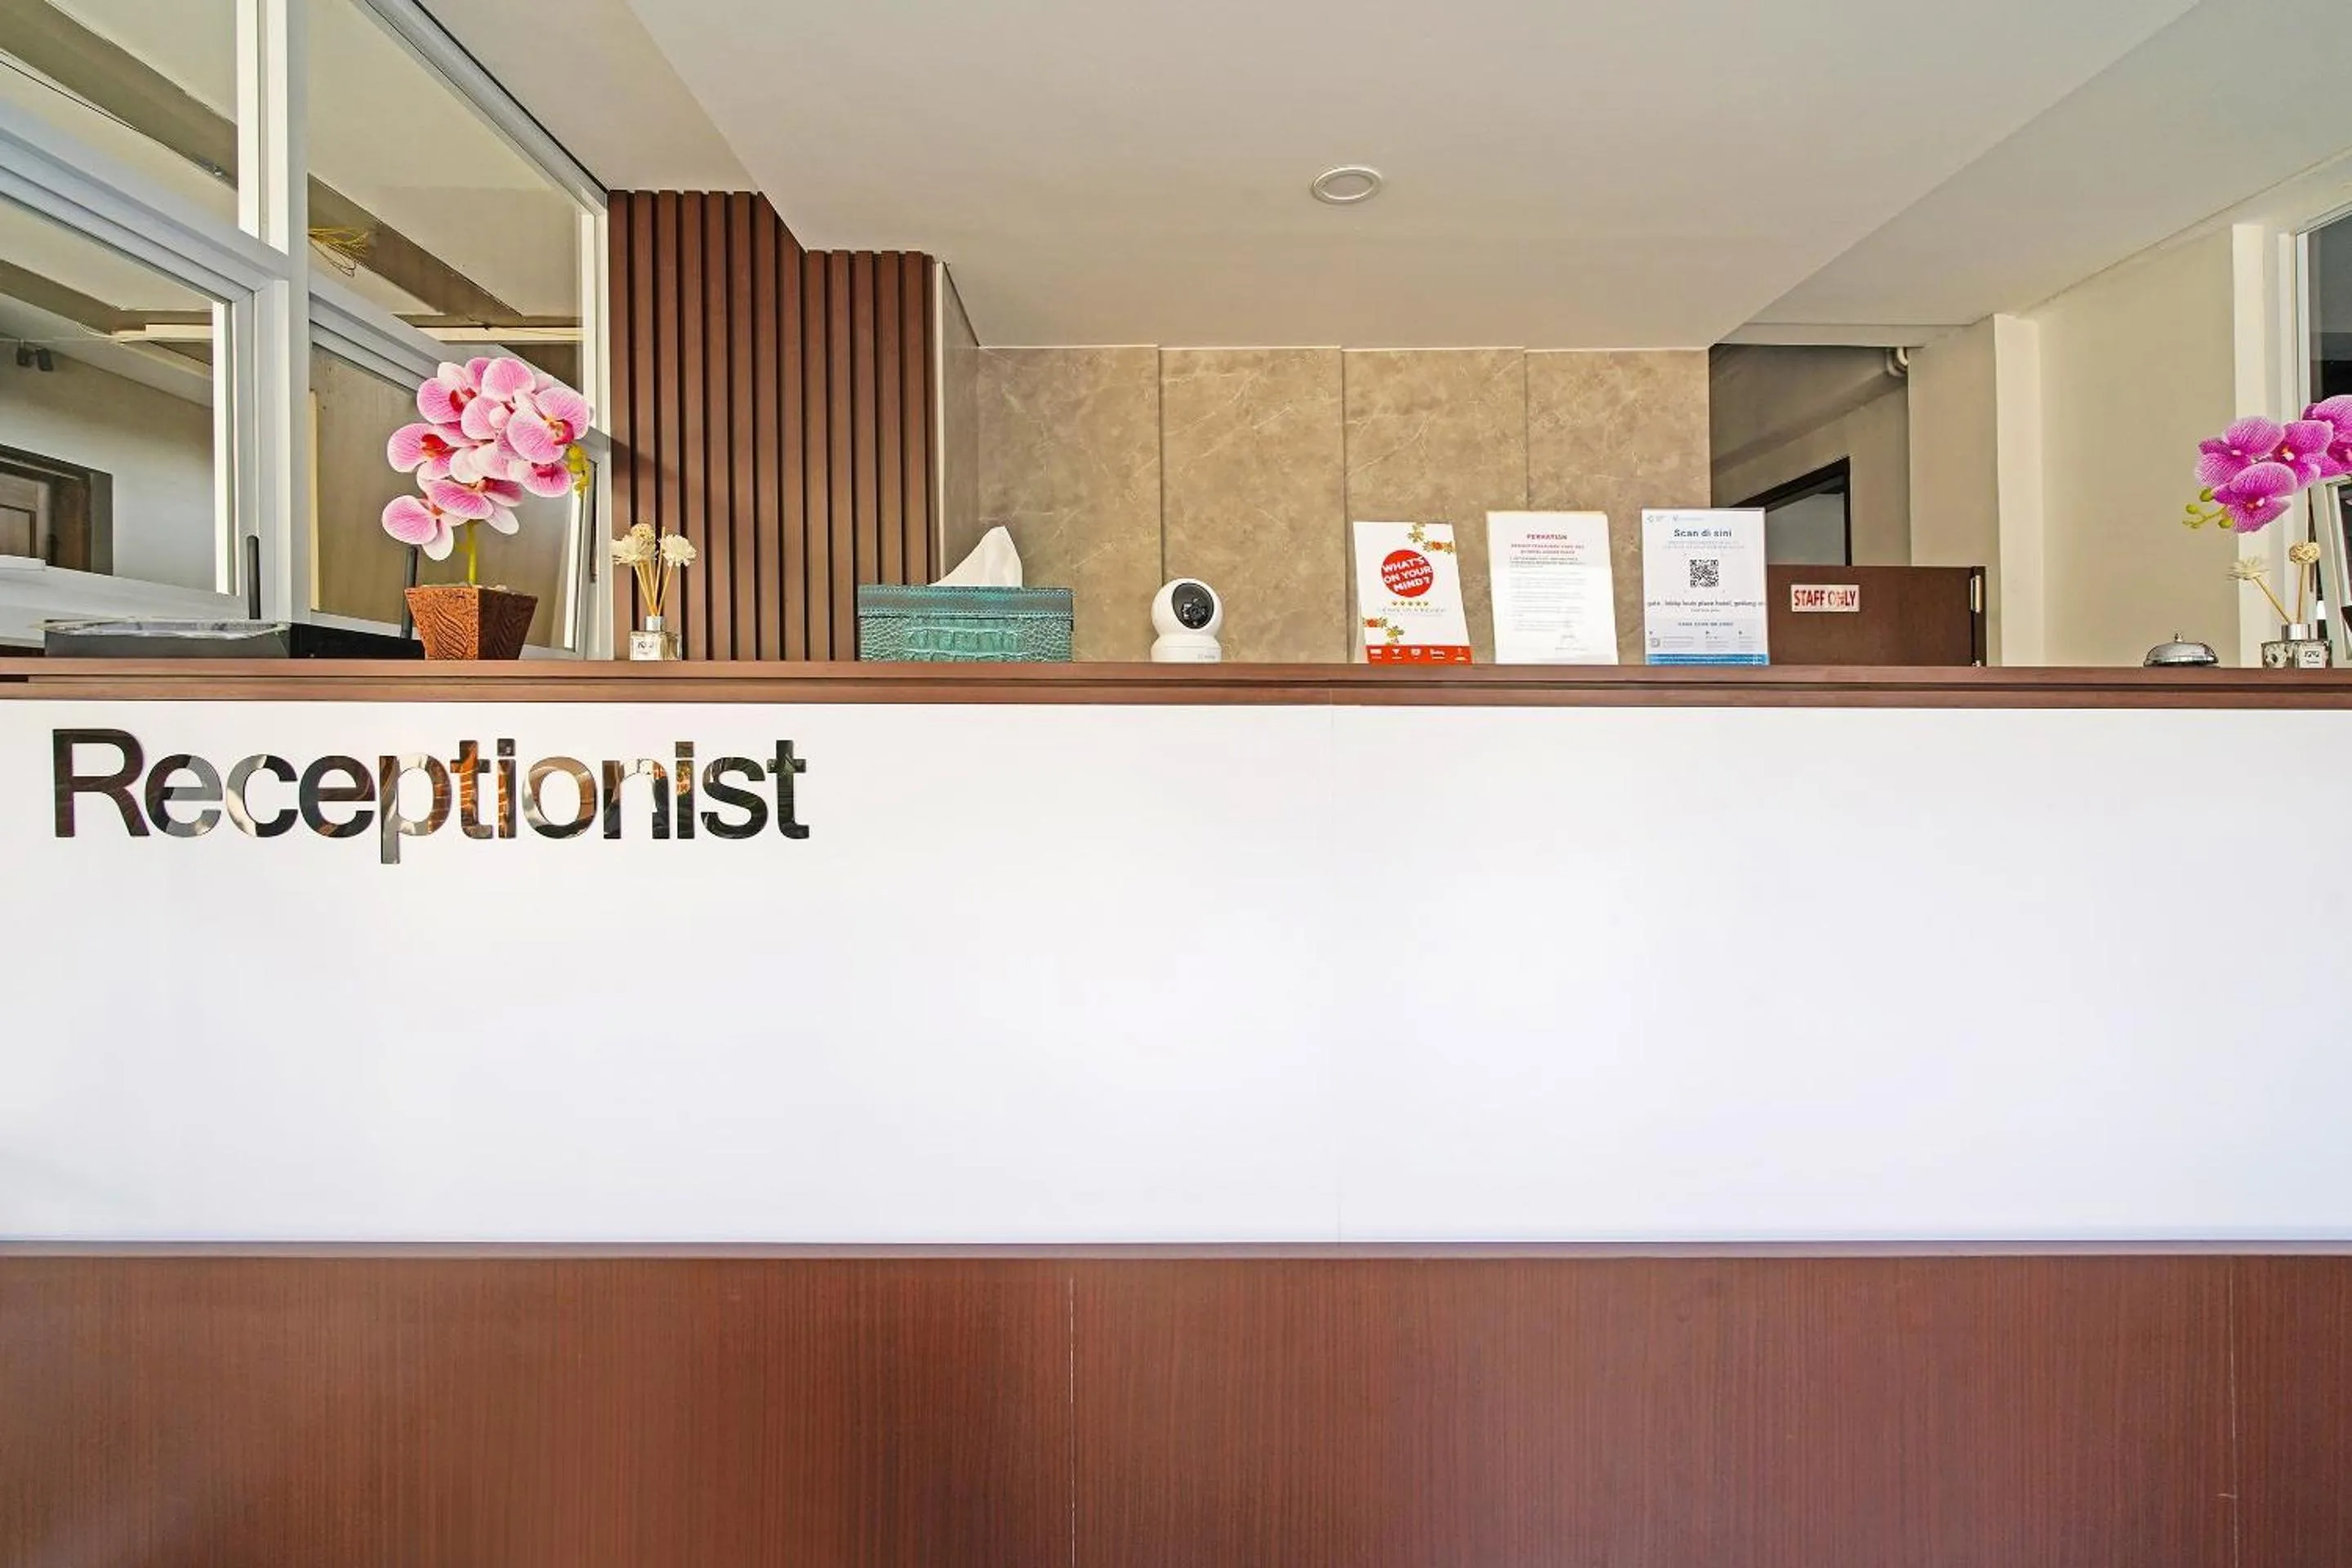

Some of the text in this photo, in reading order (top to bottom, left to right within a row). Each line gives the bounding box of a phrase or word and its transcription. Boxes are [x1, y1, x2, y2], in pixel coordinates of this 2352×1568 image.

[1673, 527, 1732, 537] Scan di sini
[1381, 556, 1425, 572] WHAT'S
[1383, 566, 1433, 584] ON YOUR
[1793, 590, 1826, 606] STAFF
[52, 728, 811, 864] Receptionist
